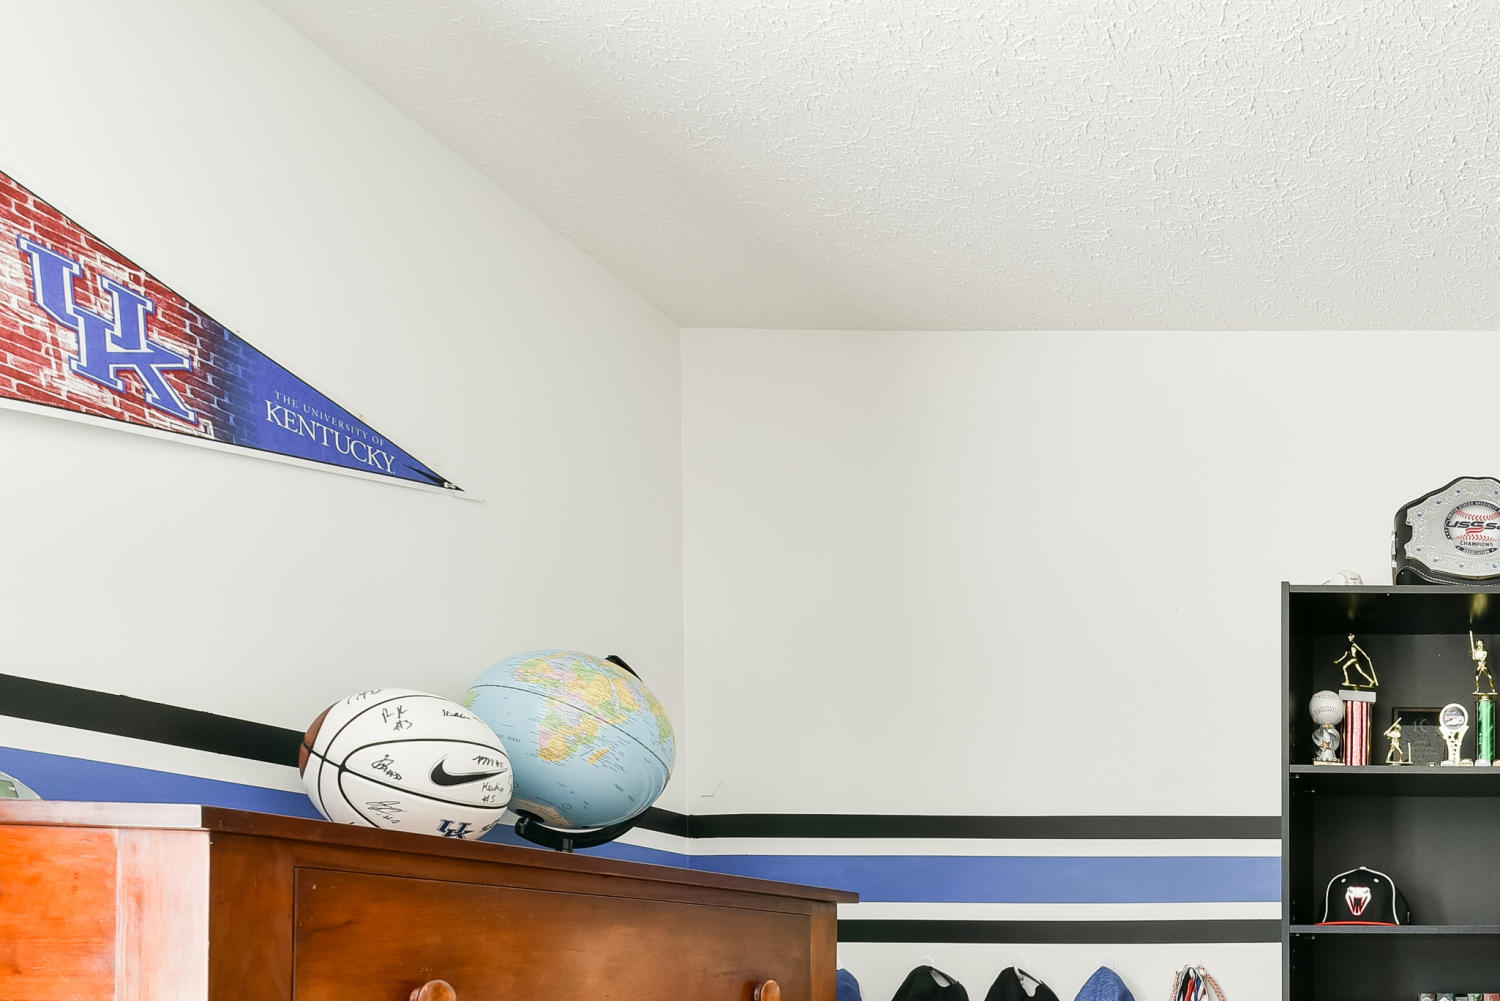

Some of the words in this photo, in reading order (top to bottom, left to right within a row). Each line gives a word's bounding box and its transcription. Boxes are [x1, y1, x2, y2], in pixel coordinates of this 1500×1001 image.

[17, 234, 198, 424] UK
[265, 400, 396, 474] KENTUCKY
[274, 391, 299, 408] THE
[303, 404, 369, 440] UNIVERSITY
[371, 435, 386, 447] OF
